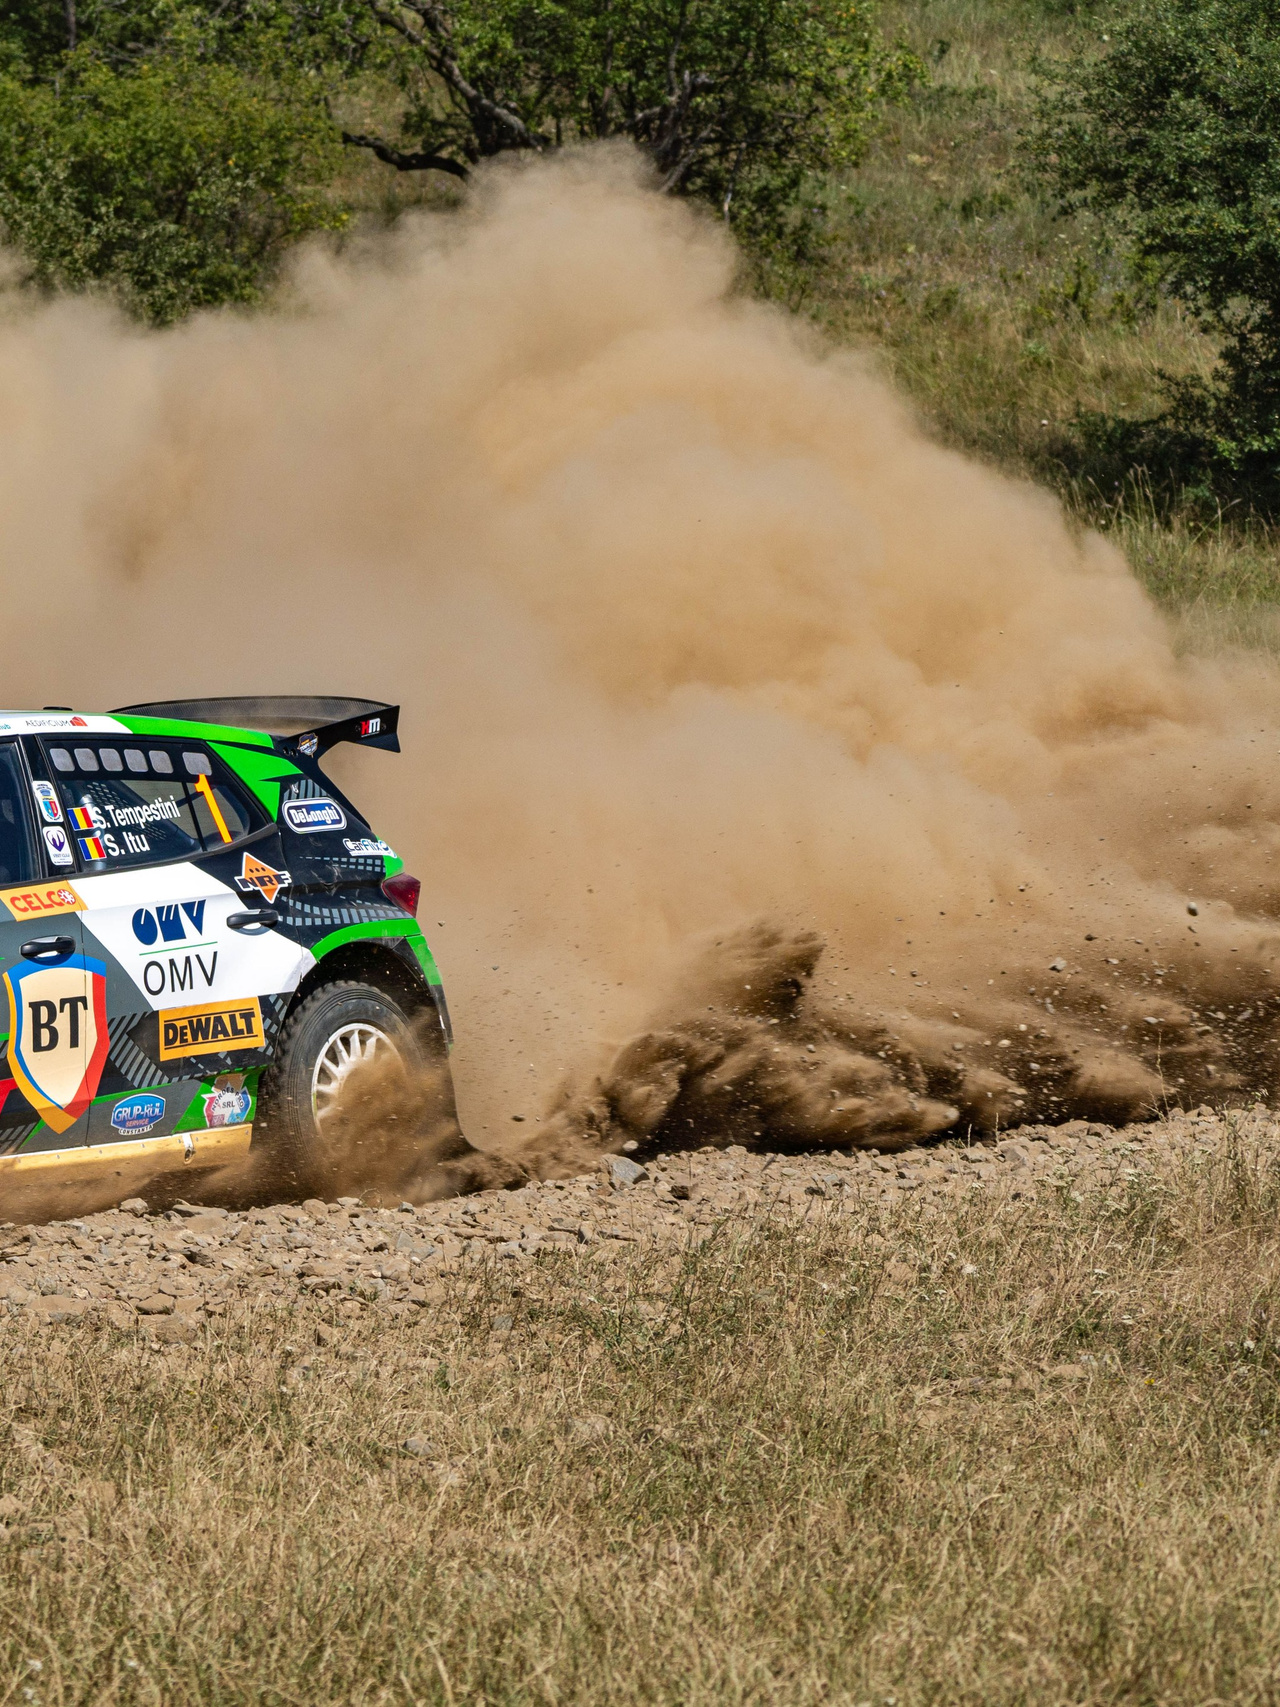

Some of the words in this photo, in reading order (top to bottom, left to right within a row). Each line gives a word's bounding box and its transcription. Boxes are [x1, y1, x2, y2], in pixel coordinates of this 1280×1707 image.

[25, 719, 70, 727] AEDIFICIUM
[105, 795, 181, 829] Tempestini
[194, 773, 233, 843] 1
[104, 834, 125, 856] S.
[124, 831, 150, 854] Itu
[236, 873, 290, 890] NRF
[143, 951, 218, 996] OMV
[28, 995, 88, 1053] BT
[222, 1100, 236, 1109] SRL
